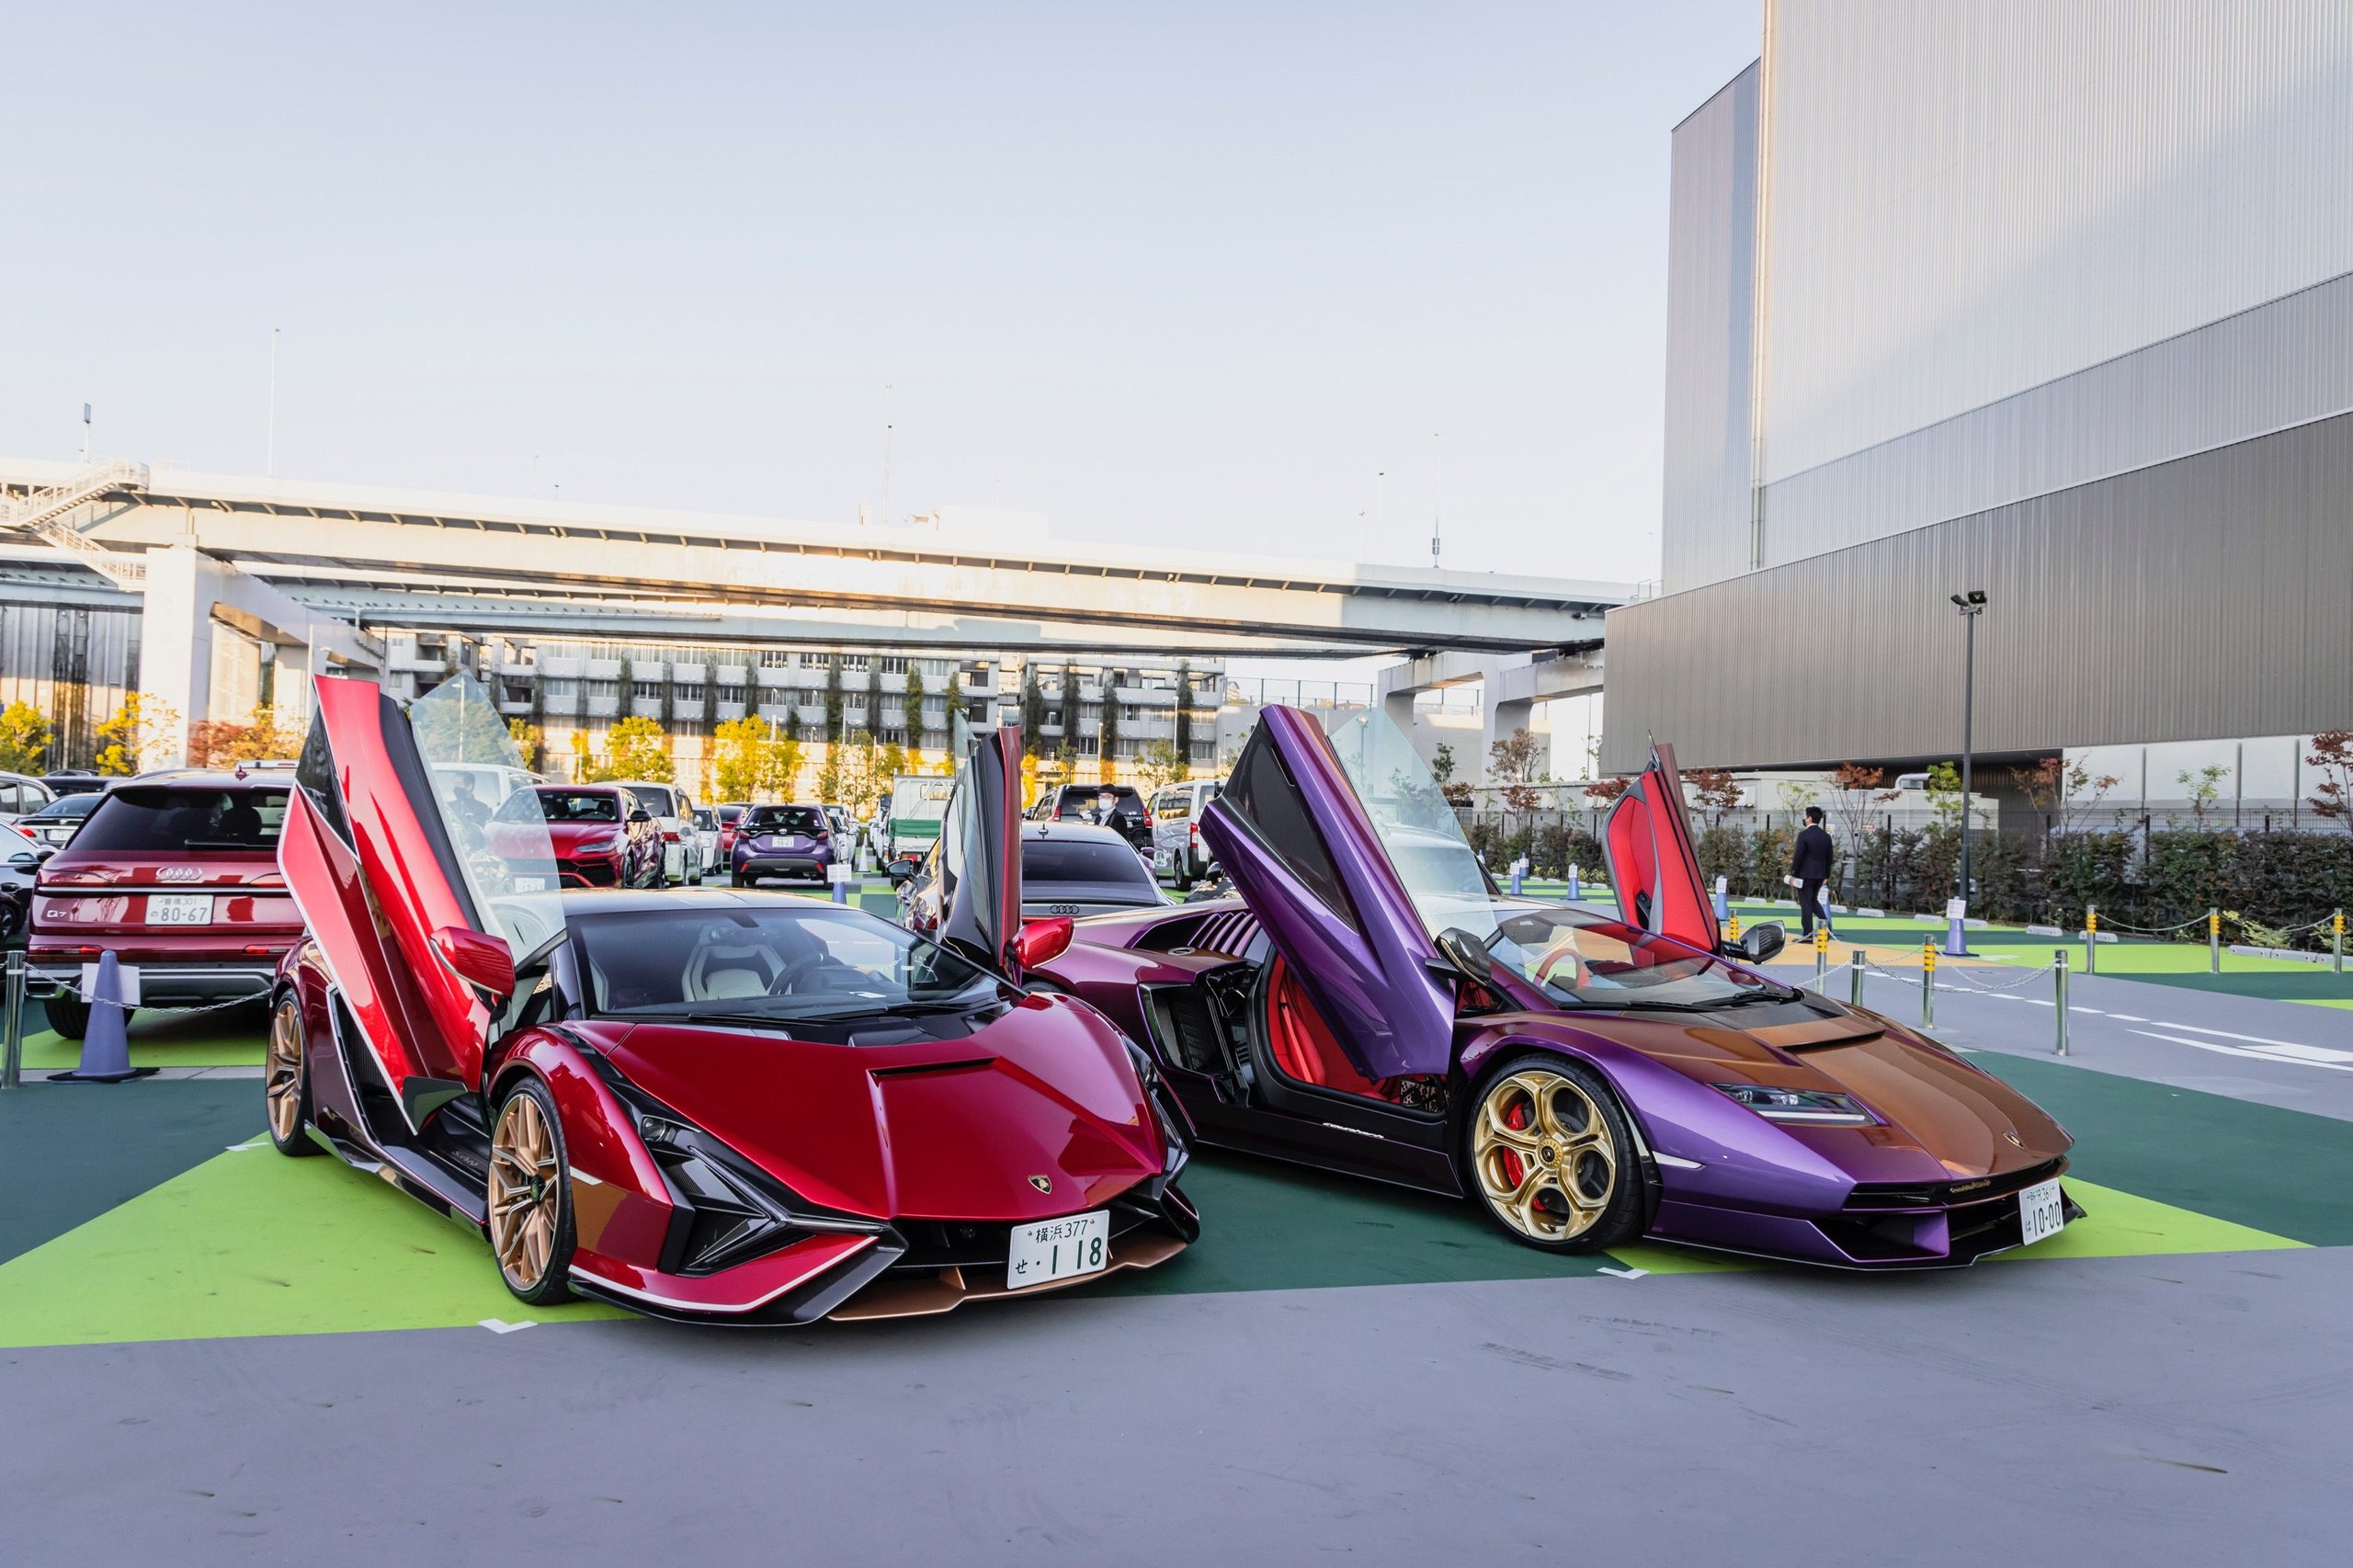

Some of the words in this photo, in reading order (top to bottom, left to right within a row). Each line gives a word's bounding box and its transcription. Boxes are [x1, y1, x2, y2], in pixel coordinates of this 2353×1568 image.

[47, 910, 67, 918] Q7
[161, 907, 208, 922] 80-67
[2033, 1201, 2062, 1236] 10-00
[1036, 1220, 1088, 1244] 横浜377
[1015, 1258, 1029, 1275] せ
